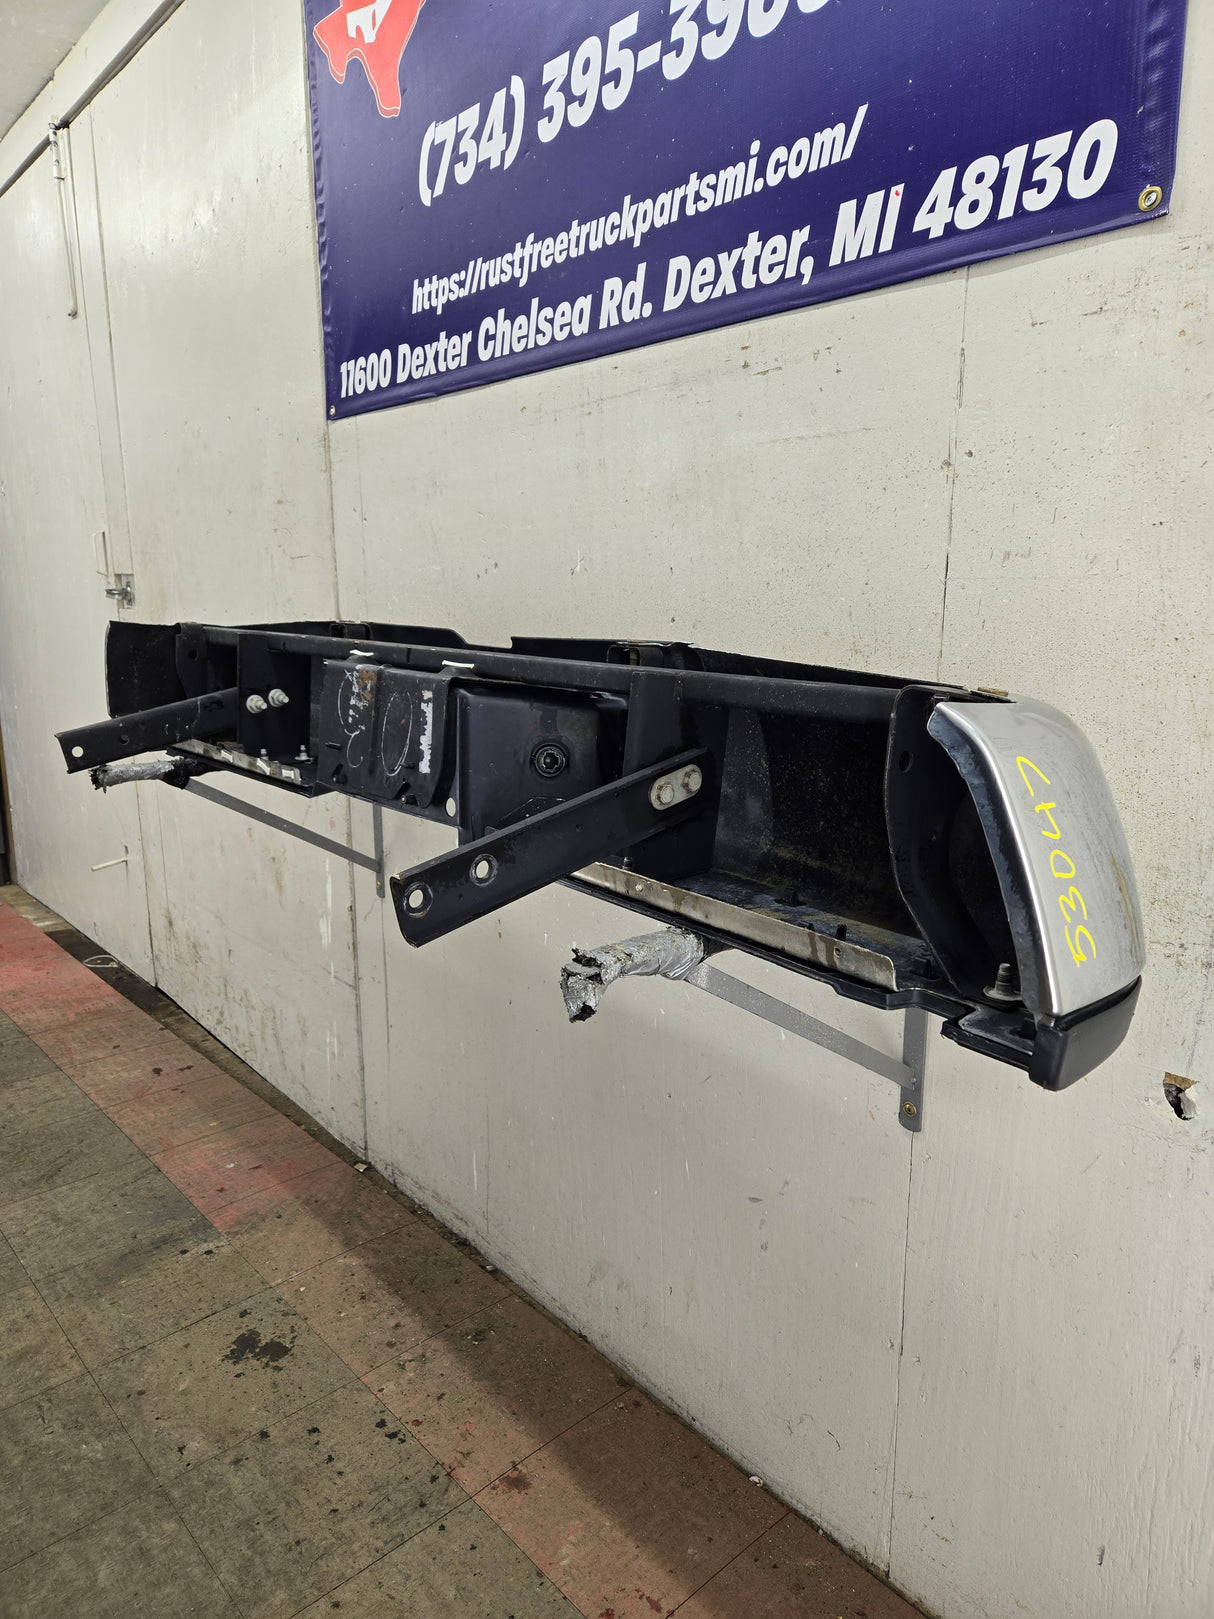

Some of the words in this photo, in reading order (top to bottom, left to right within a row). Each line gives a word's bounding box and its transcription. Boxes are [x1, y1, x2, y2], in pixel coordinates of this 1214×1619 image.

[411, 103, 869, 315] https://rustfreetruckpartsmi.com/
[418, 74, 526, 207] (734)
[537, 0, 829, 144] 395-39
[340, 348, 392, 399] 11600
[396, 328, 473, 384] Dexter
[477, 293, 593, 362] Chelsea
[598, 261, 653, 330] Rd.
[662, 224, 815, 313] Dexter,
[828, 182, 905, 267] MI
[912, 118, 1119, 240] 48130
[1016, 755, 1097, 968] 53047
